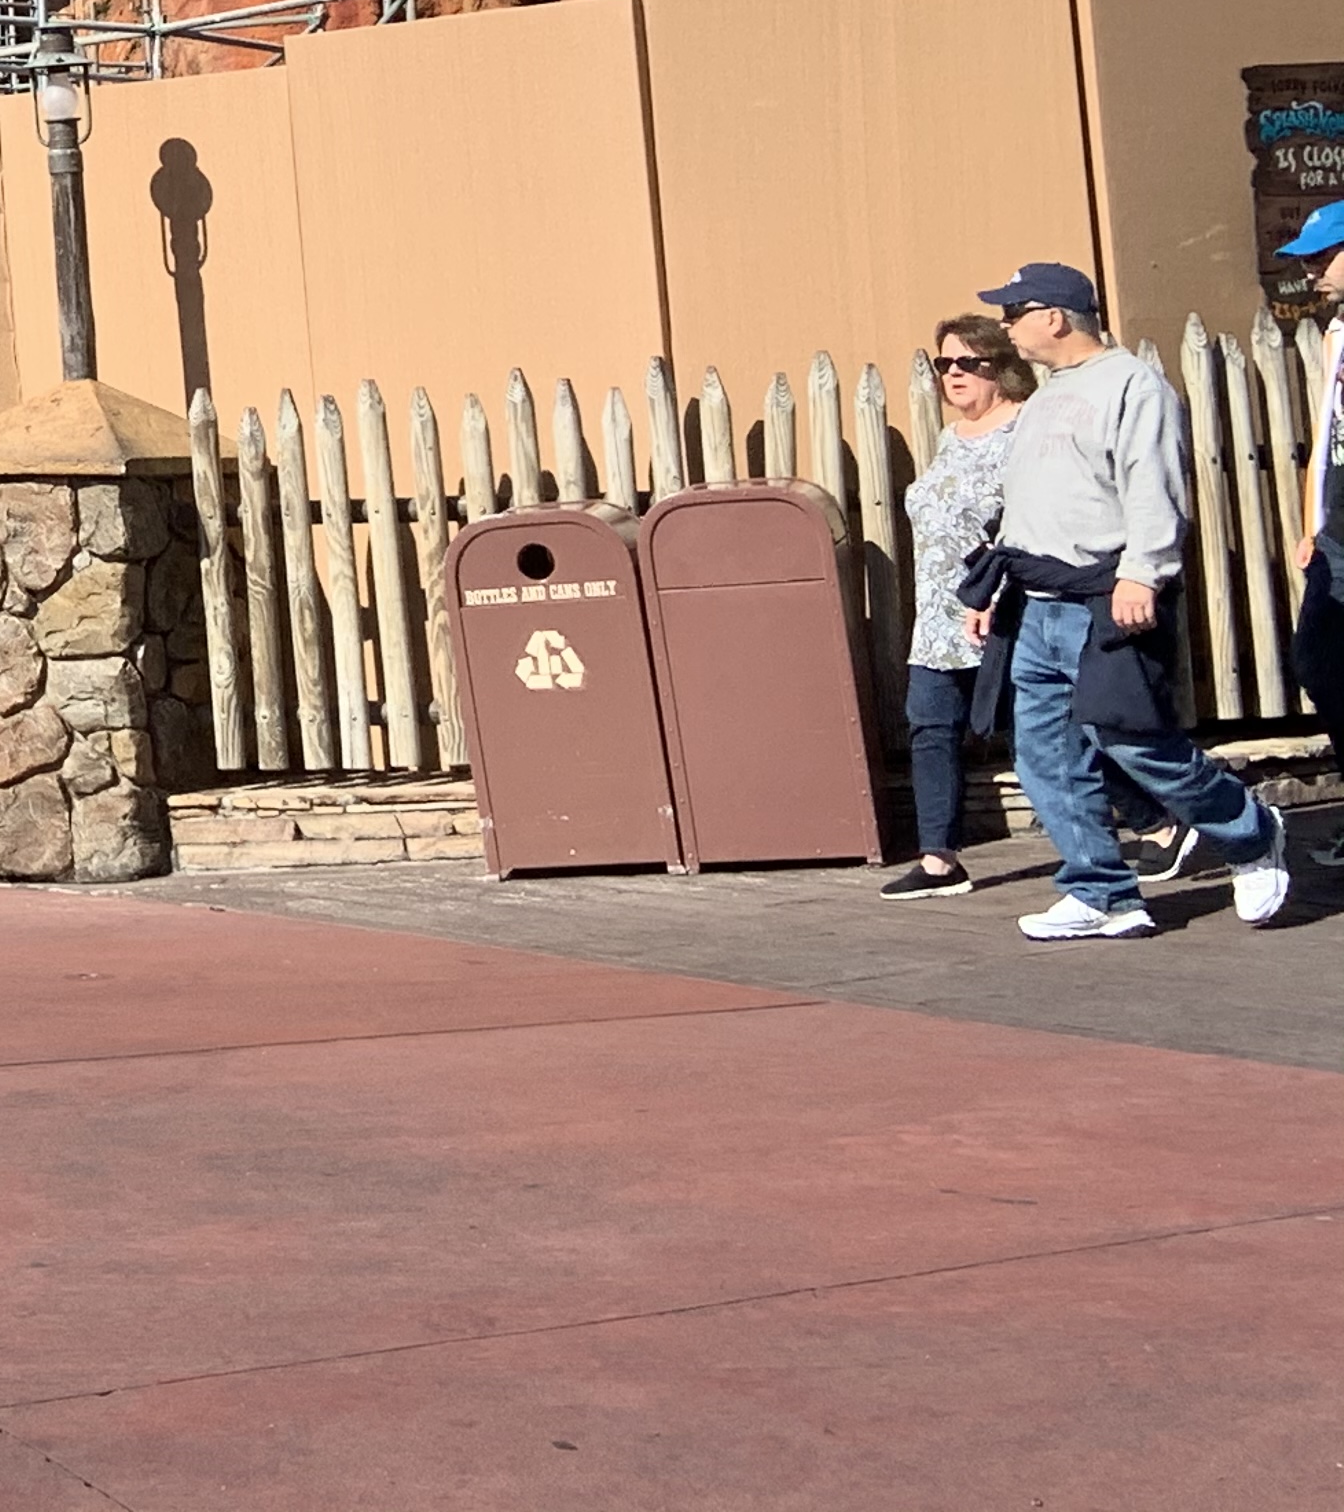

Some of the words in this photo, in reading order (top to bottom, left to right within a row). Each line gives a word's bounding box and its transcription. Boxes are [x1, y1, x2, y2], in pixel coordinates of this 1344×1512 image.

[1259, 108, 1315, 145] SPLASH
[1275, 147, 1297, 173] IS
[1303, 144, 1344, 172] CLOS
[1300, 169, 1325, 191] FOR
[1328, 172, 1339, 187] A
[464, 587, 518, 605] BOTTLES
[521, 585, 546, 602] AND
[549, 582, 581, 600] CANS
[584, 580, 617, 597] ONLY
